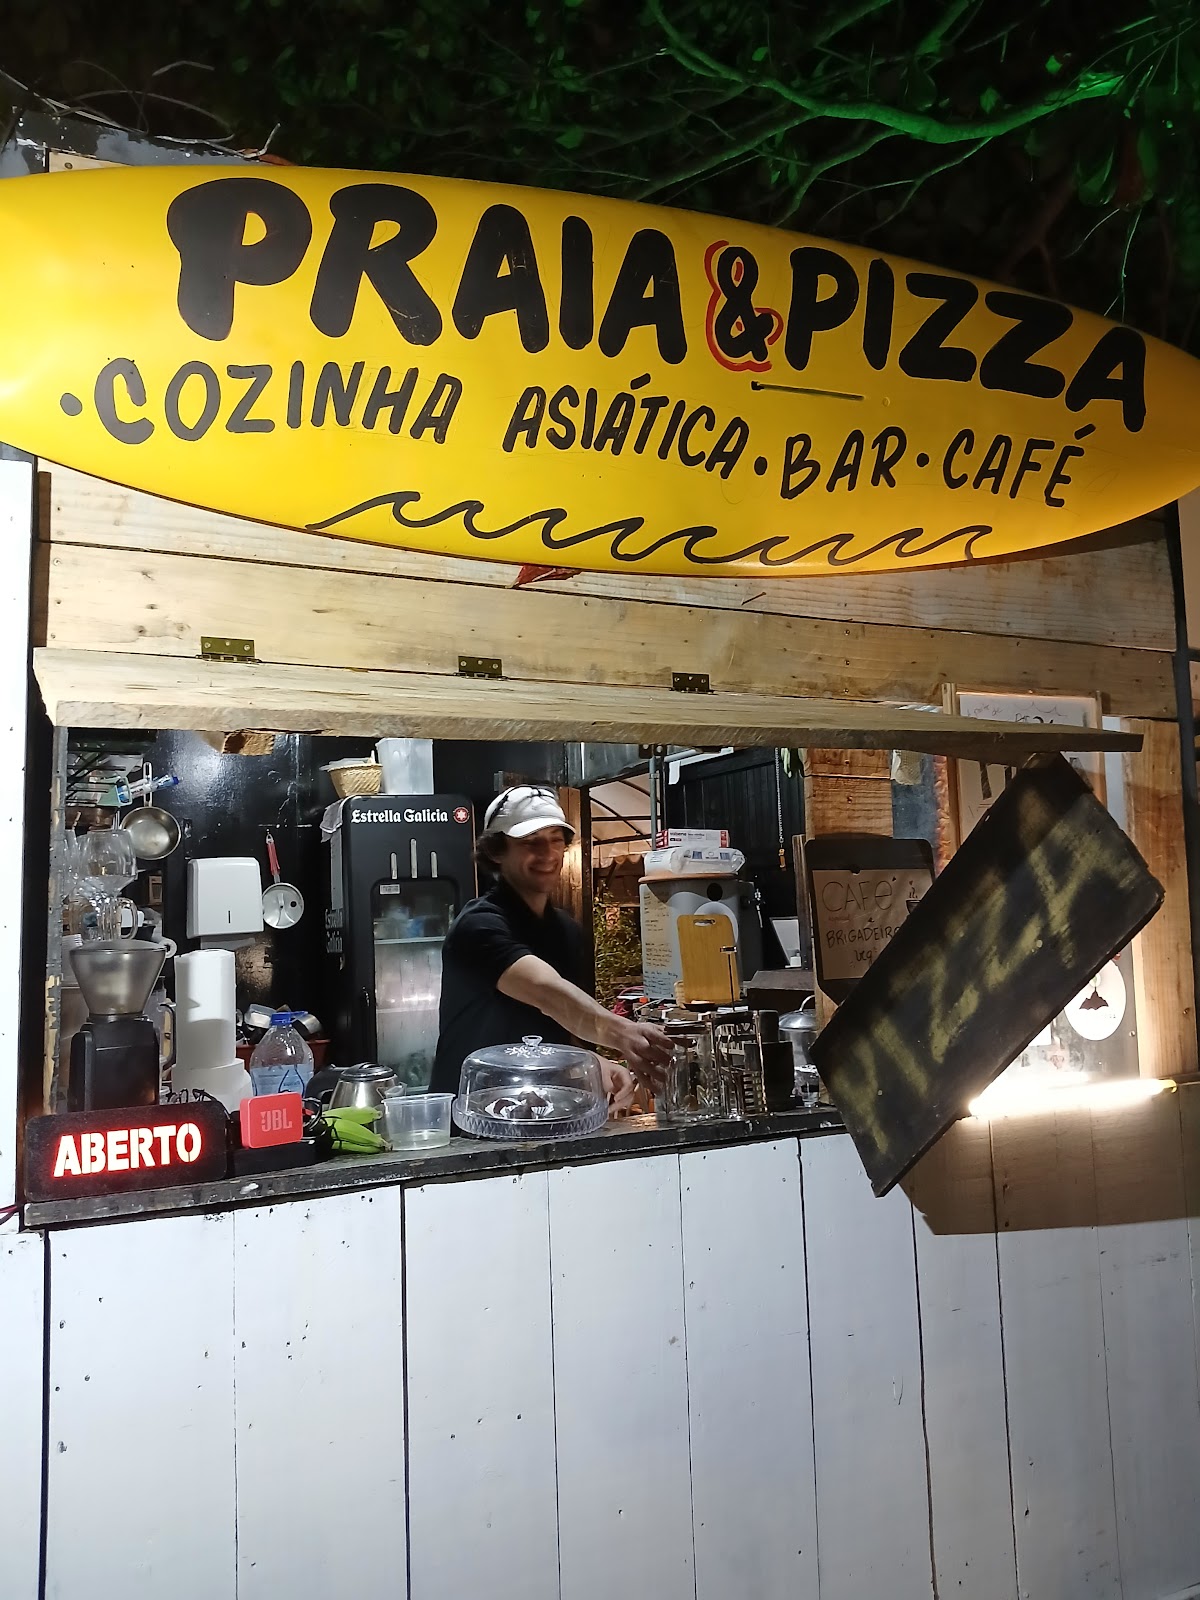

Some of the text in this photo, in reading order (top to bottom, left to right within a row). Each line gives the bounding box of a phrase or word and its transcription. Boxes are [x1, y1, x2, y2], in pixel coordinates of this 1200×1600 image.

[166, 177, 1147, 433] PRAIA & PIZZA
[94, 357, 1096, 507] COZINHA ASIÁTICA BAR CAFÉ
[350, 808, 449, 823] Estrella Galicia
[260, 1109, 293, 1132] JBL
[53, 1122, 202, 1177] ABERTO
